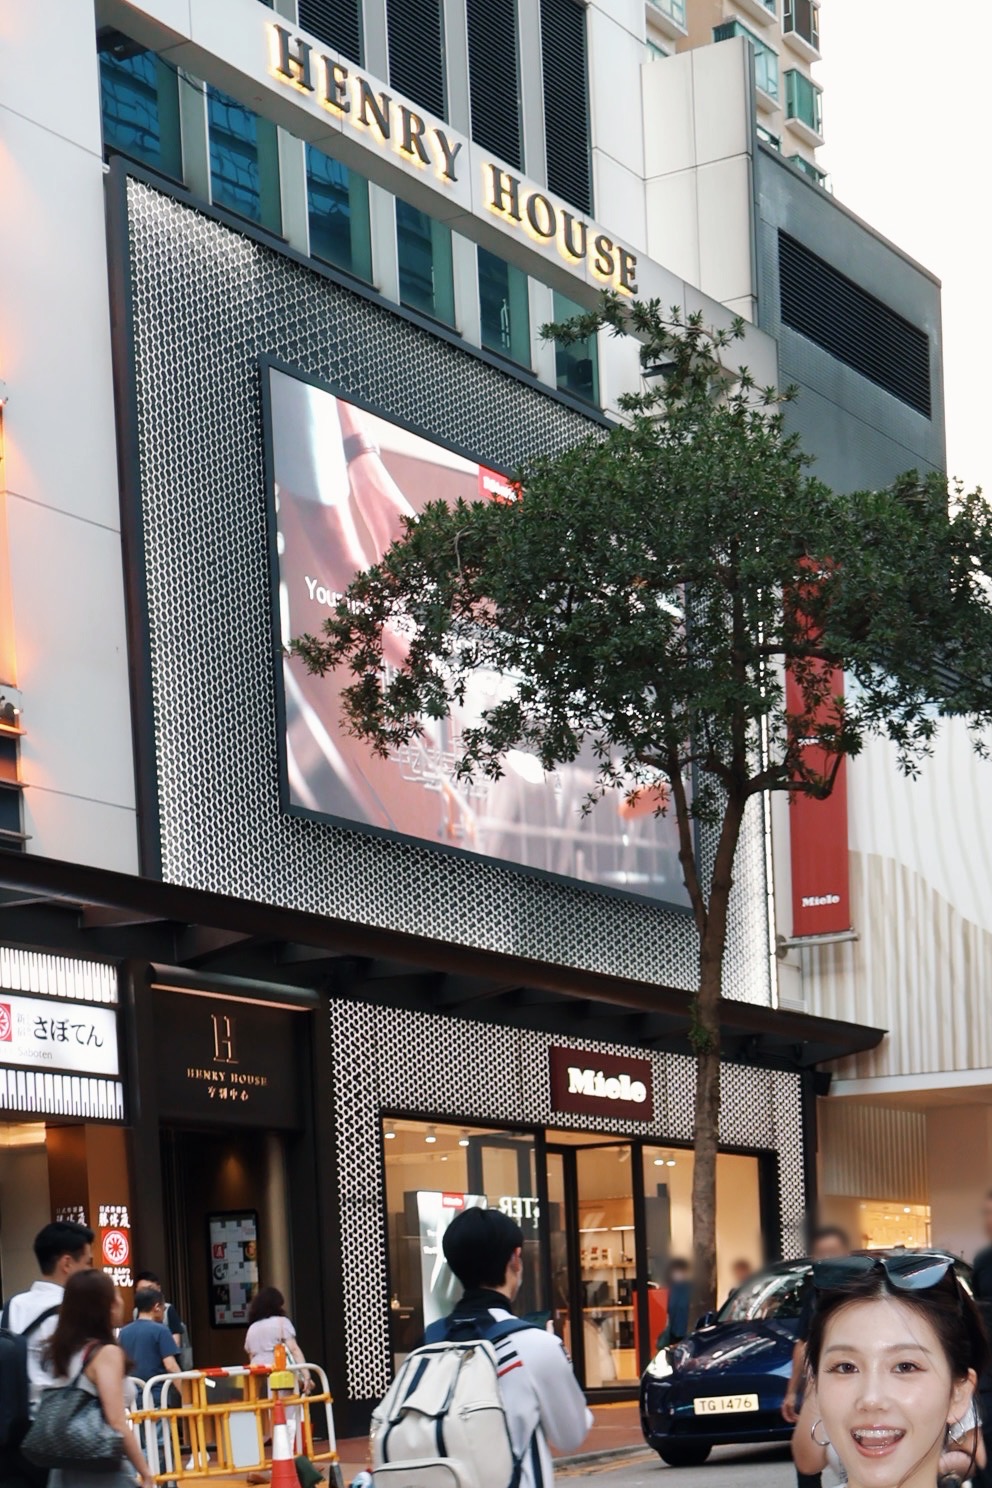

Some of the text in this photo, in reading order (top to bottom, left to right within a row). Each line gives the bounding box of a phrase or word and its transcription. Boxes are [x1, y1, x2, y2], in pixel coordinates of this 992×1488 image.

[273, 23, 639, 295] HENRY HOUSE
[802, 895, 841, 908] Miele
[33, 1016, 104, 1048] さぼてん
[186, 1068, 268, 1087] HENRY HOUSE
[567, 1066, 647, 1103] Miele
[700, 1397, 752, 1412] TG 1476
